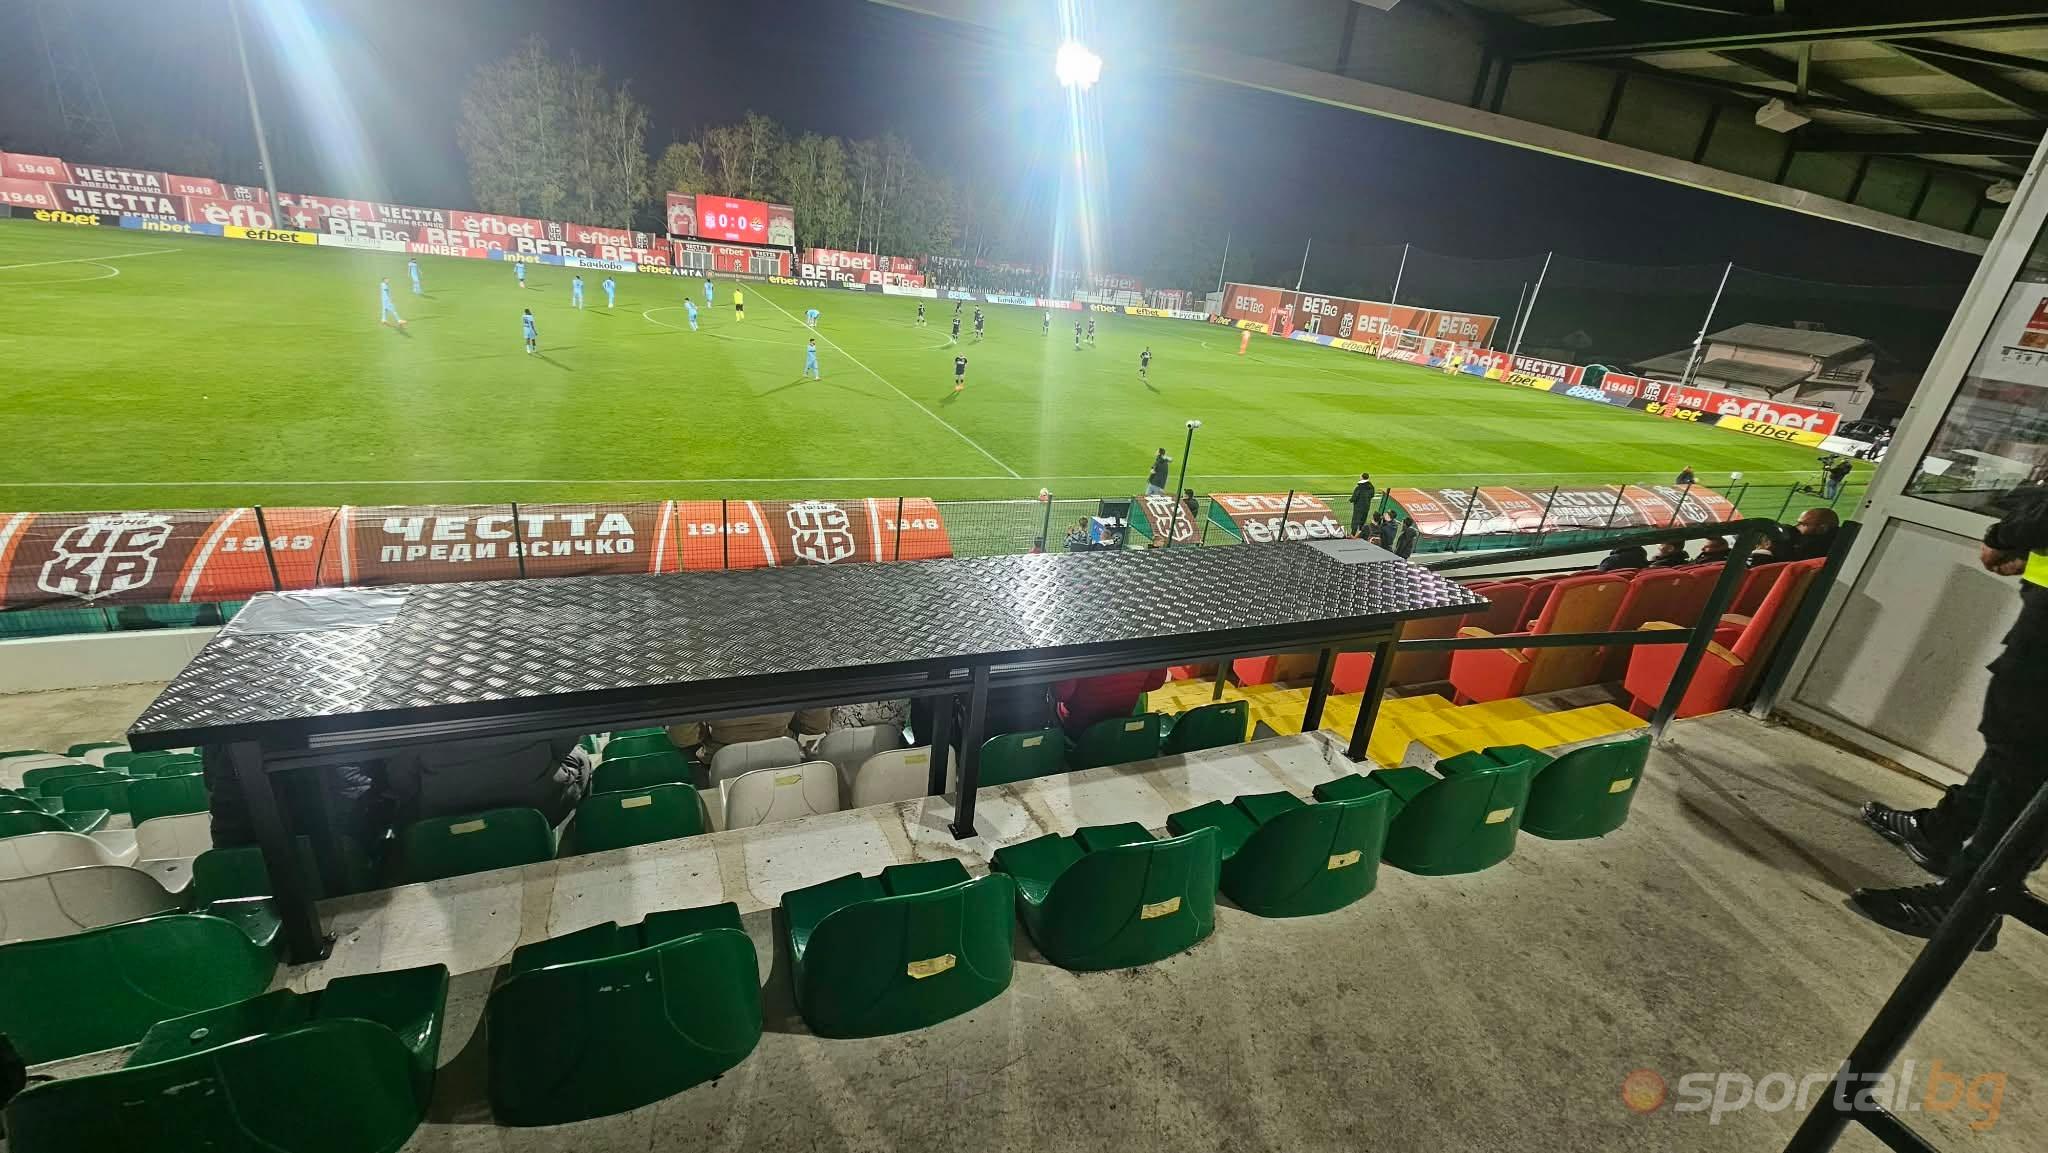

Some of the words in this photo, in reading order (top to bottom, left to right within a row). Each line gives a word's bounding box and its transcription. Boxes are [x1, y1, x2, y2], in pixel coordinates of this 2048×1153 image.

[75, 167, 160, 188] ЧЕСТТА
[180, 184, 212, 195] 1948
[1, 192, 48, 204] 1948
[65, 189, 176, 215] ЧЕСТТА
[378, 206, 443, 222] ЧЕСТТА
[142, 219, 192, 233] inbet
[246, 229, 299, 242] efbet
[411, 242, 469, 257] WINBET
[672, 266, 702, 277] ЛИГА
[1516, 357, 1566, 378] ЧЕСТТА
[1604, 381, 1635, 395] 1948
[383, 512, 635, 541] ЧЕСТТА
[687, 521, 750, 536] 1948
[220, 535, 313, 552] 1948
[380, 543, 497, 562] ПРЕДИ
[508, 538, 635, 557] ВСИЧКО
